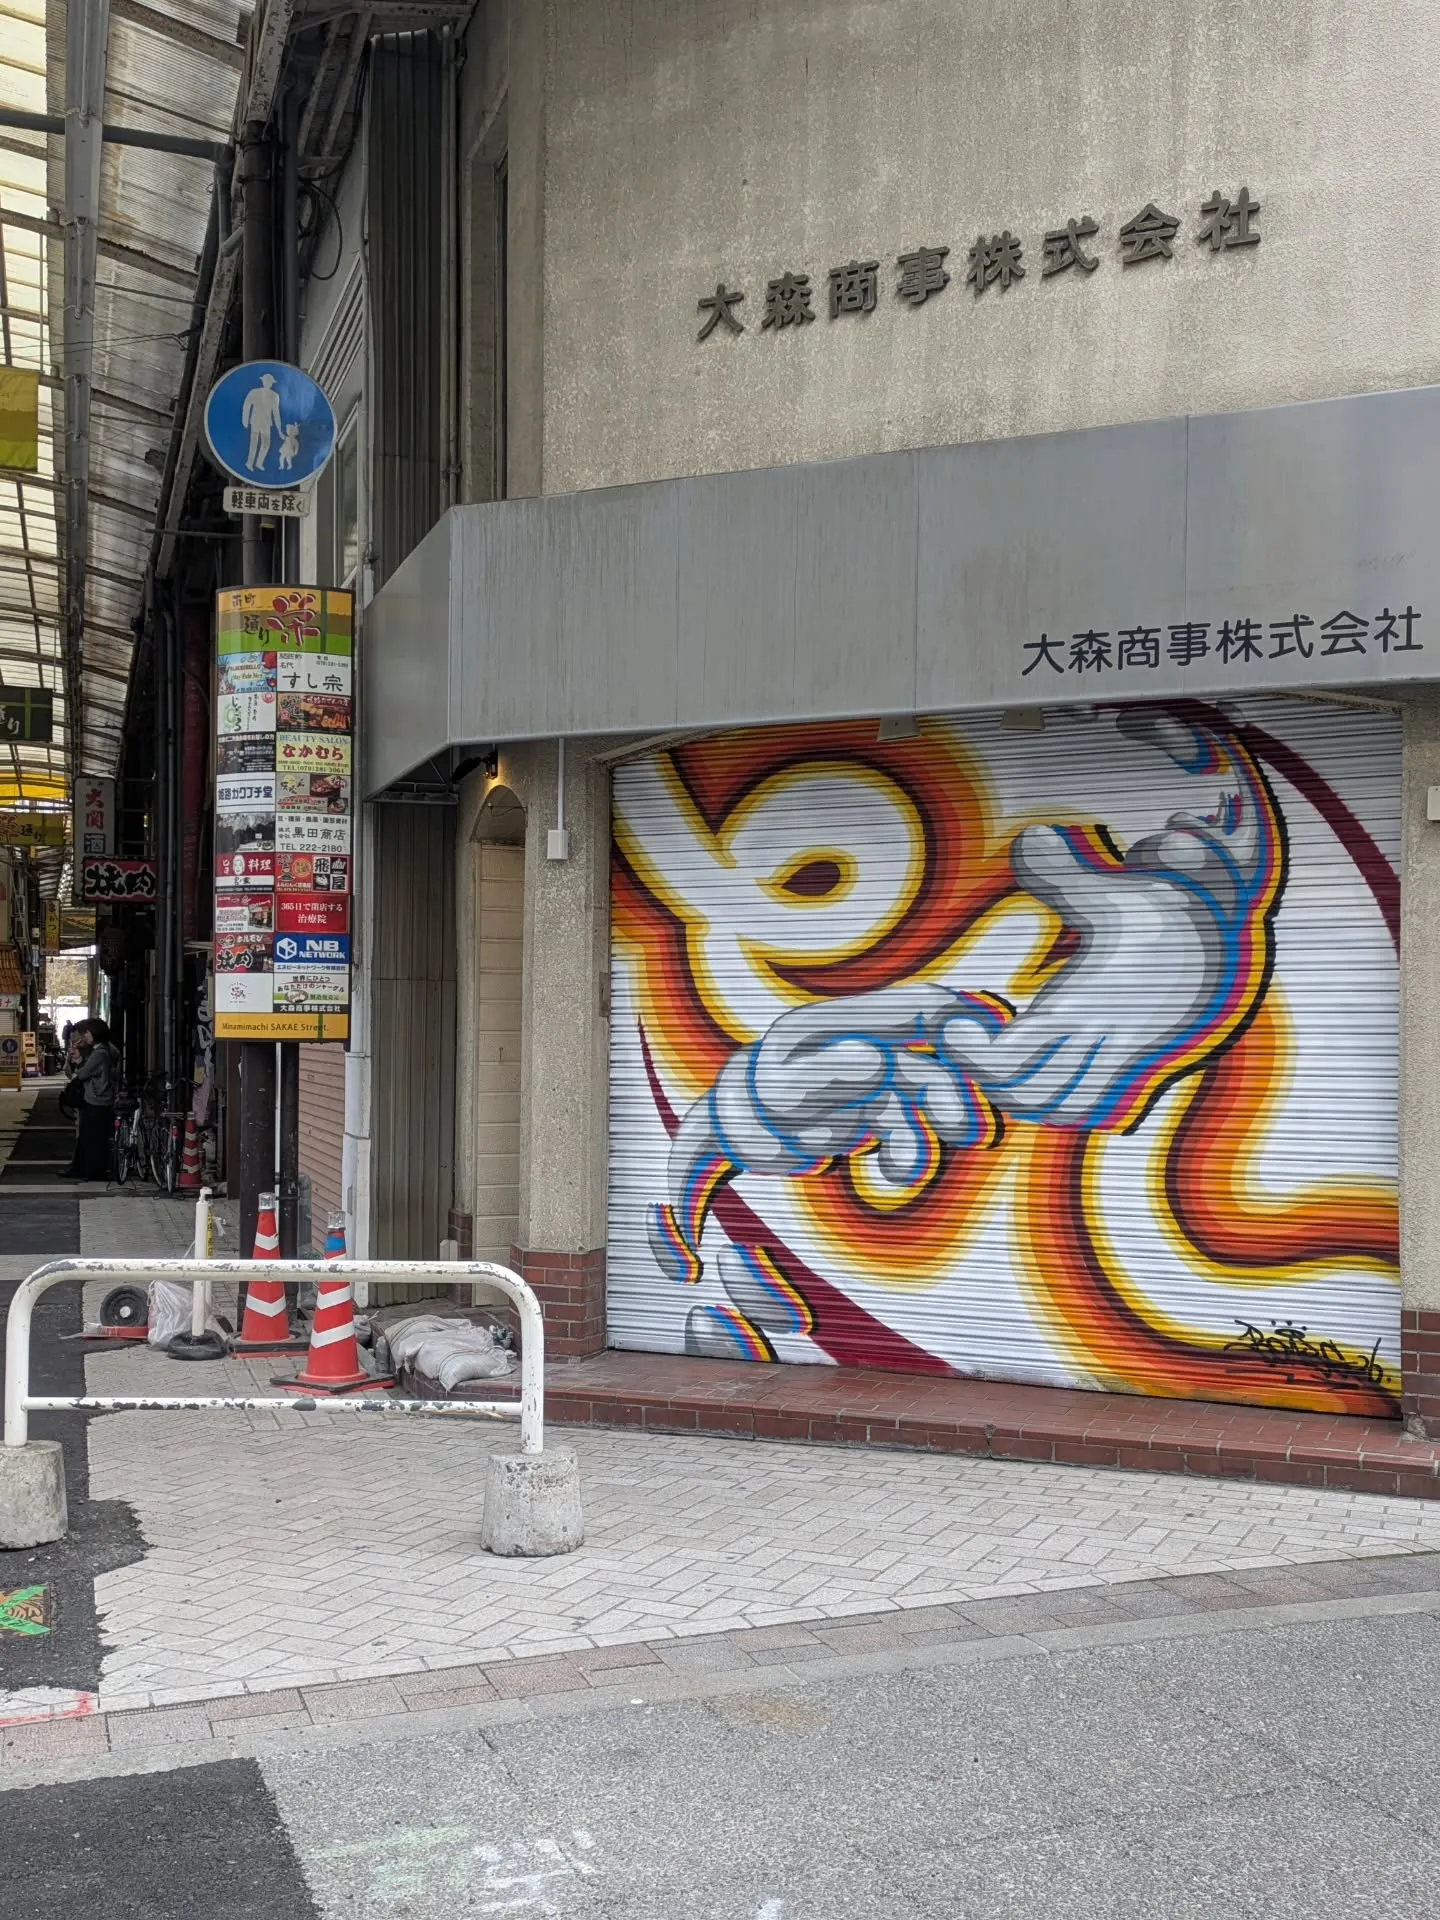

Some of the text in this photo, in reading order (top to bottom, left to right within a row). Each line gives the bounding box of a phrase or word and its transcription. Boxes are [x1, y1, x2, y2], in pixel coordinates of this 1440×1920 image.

[698, 187, 1261, 341] 大森商事株式会社
[232, 491, 302, 512] 軽車両を除く
[1021, 605, 1424, 677] 大森商事株式会社
[282, 671, 344, 692] すし宗
[282, 743, 344, 760] なかむら
[280, 843, 296, 851] TEL
[300, 844, 343, 853] 222-2180
[247, 858, 272, 873] 料理
[85, 862, 157, 898] 焼肉
[297, 914, 327, 924] 治療院
[306, 939, 339, 951] NB
[215, 948, 253, 972] 焼肉
[299, 951, 346, 959] NETWORK
[292, 975, 331, 983] 世界にひとつ
[222, 1023, 269, 1031] Minamimachi
